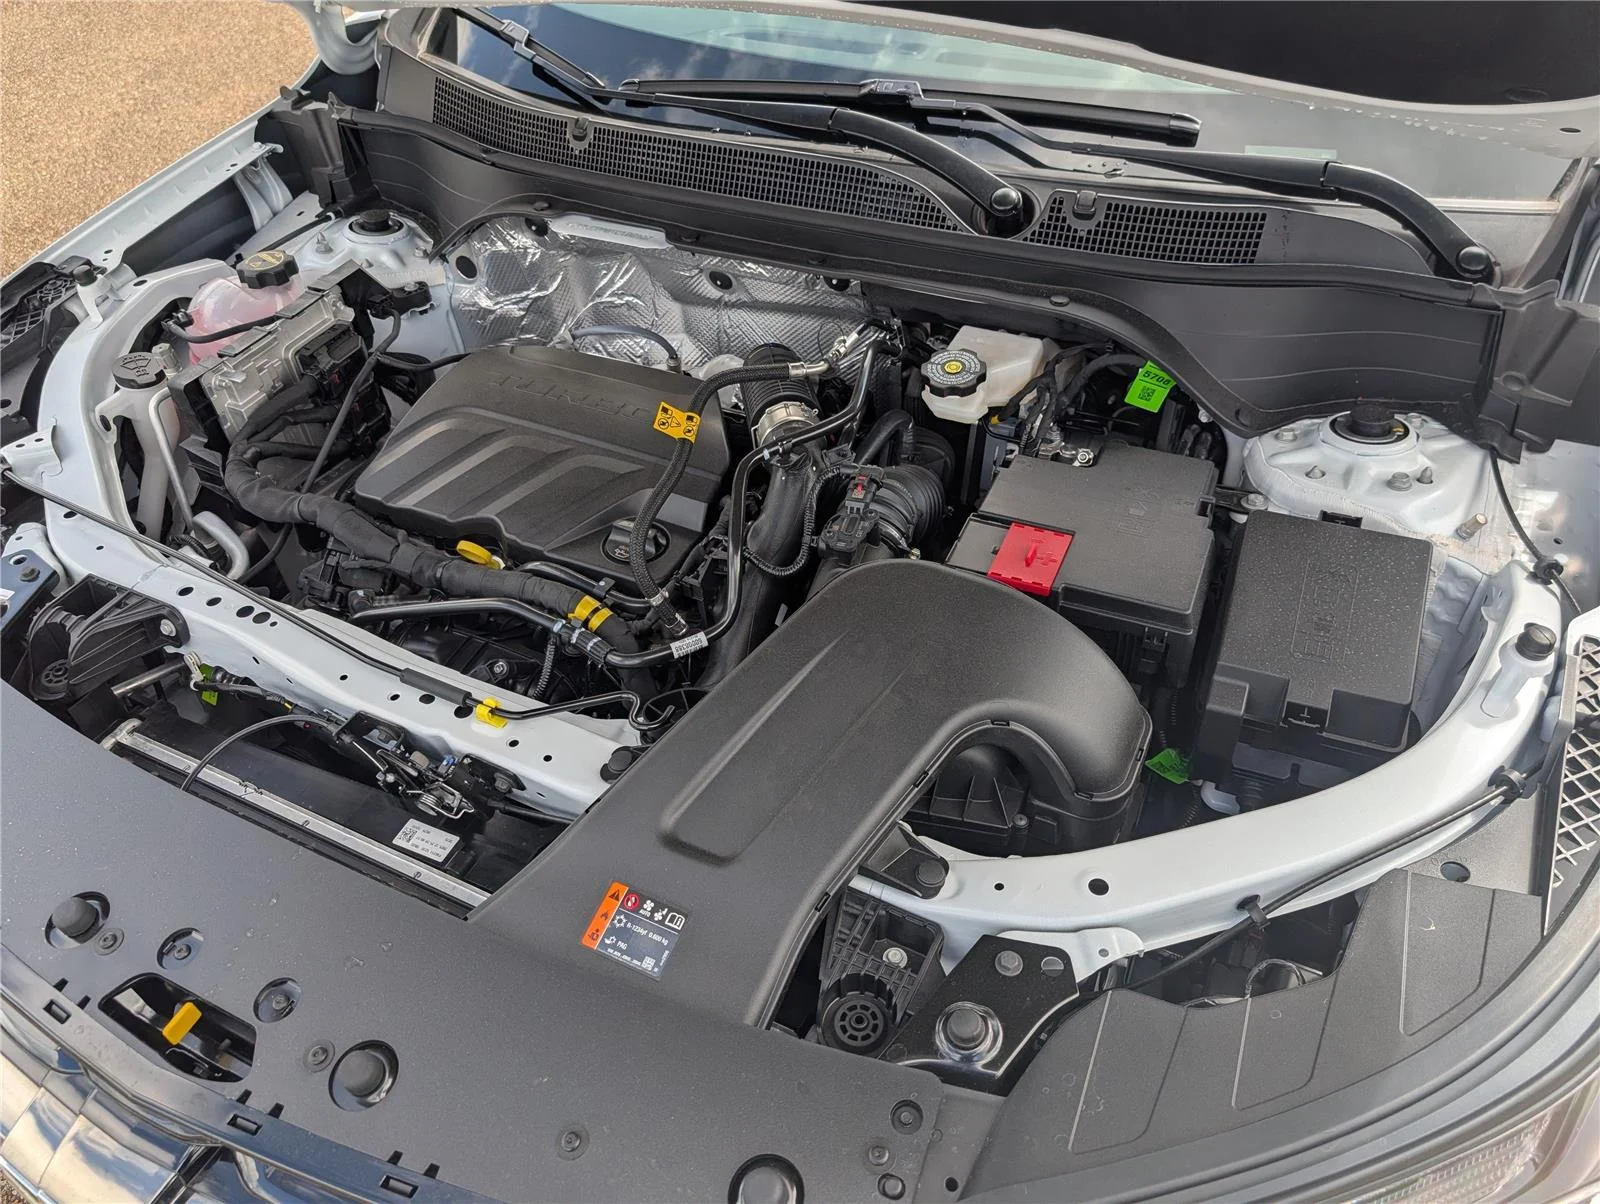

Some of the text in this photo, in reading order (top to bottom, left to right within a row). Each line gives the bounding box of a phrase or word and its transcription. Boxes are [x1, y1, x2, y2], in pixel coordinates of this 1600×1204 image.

[639, 909, 651, 917] AUTO
[626, 922, 648, 935] R-1234yf
[661, 938, 669, 946] kg
[617, 940, 628, 950] PAG
